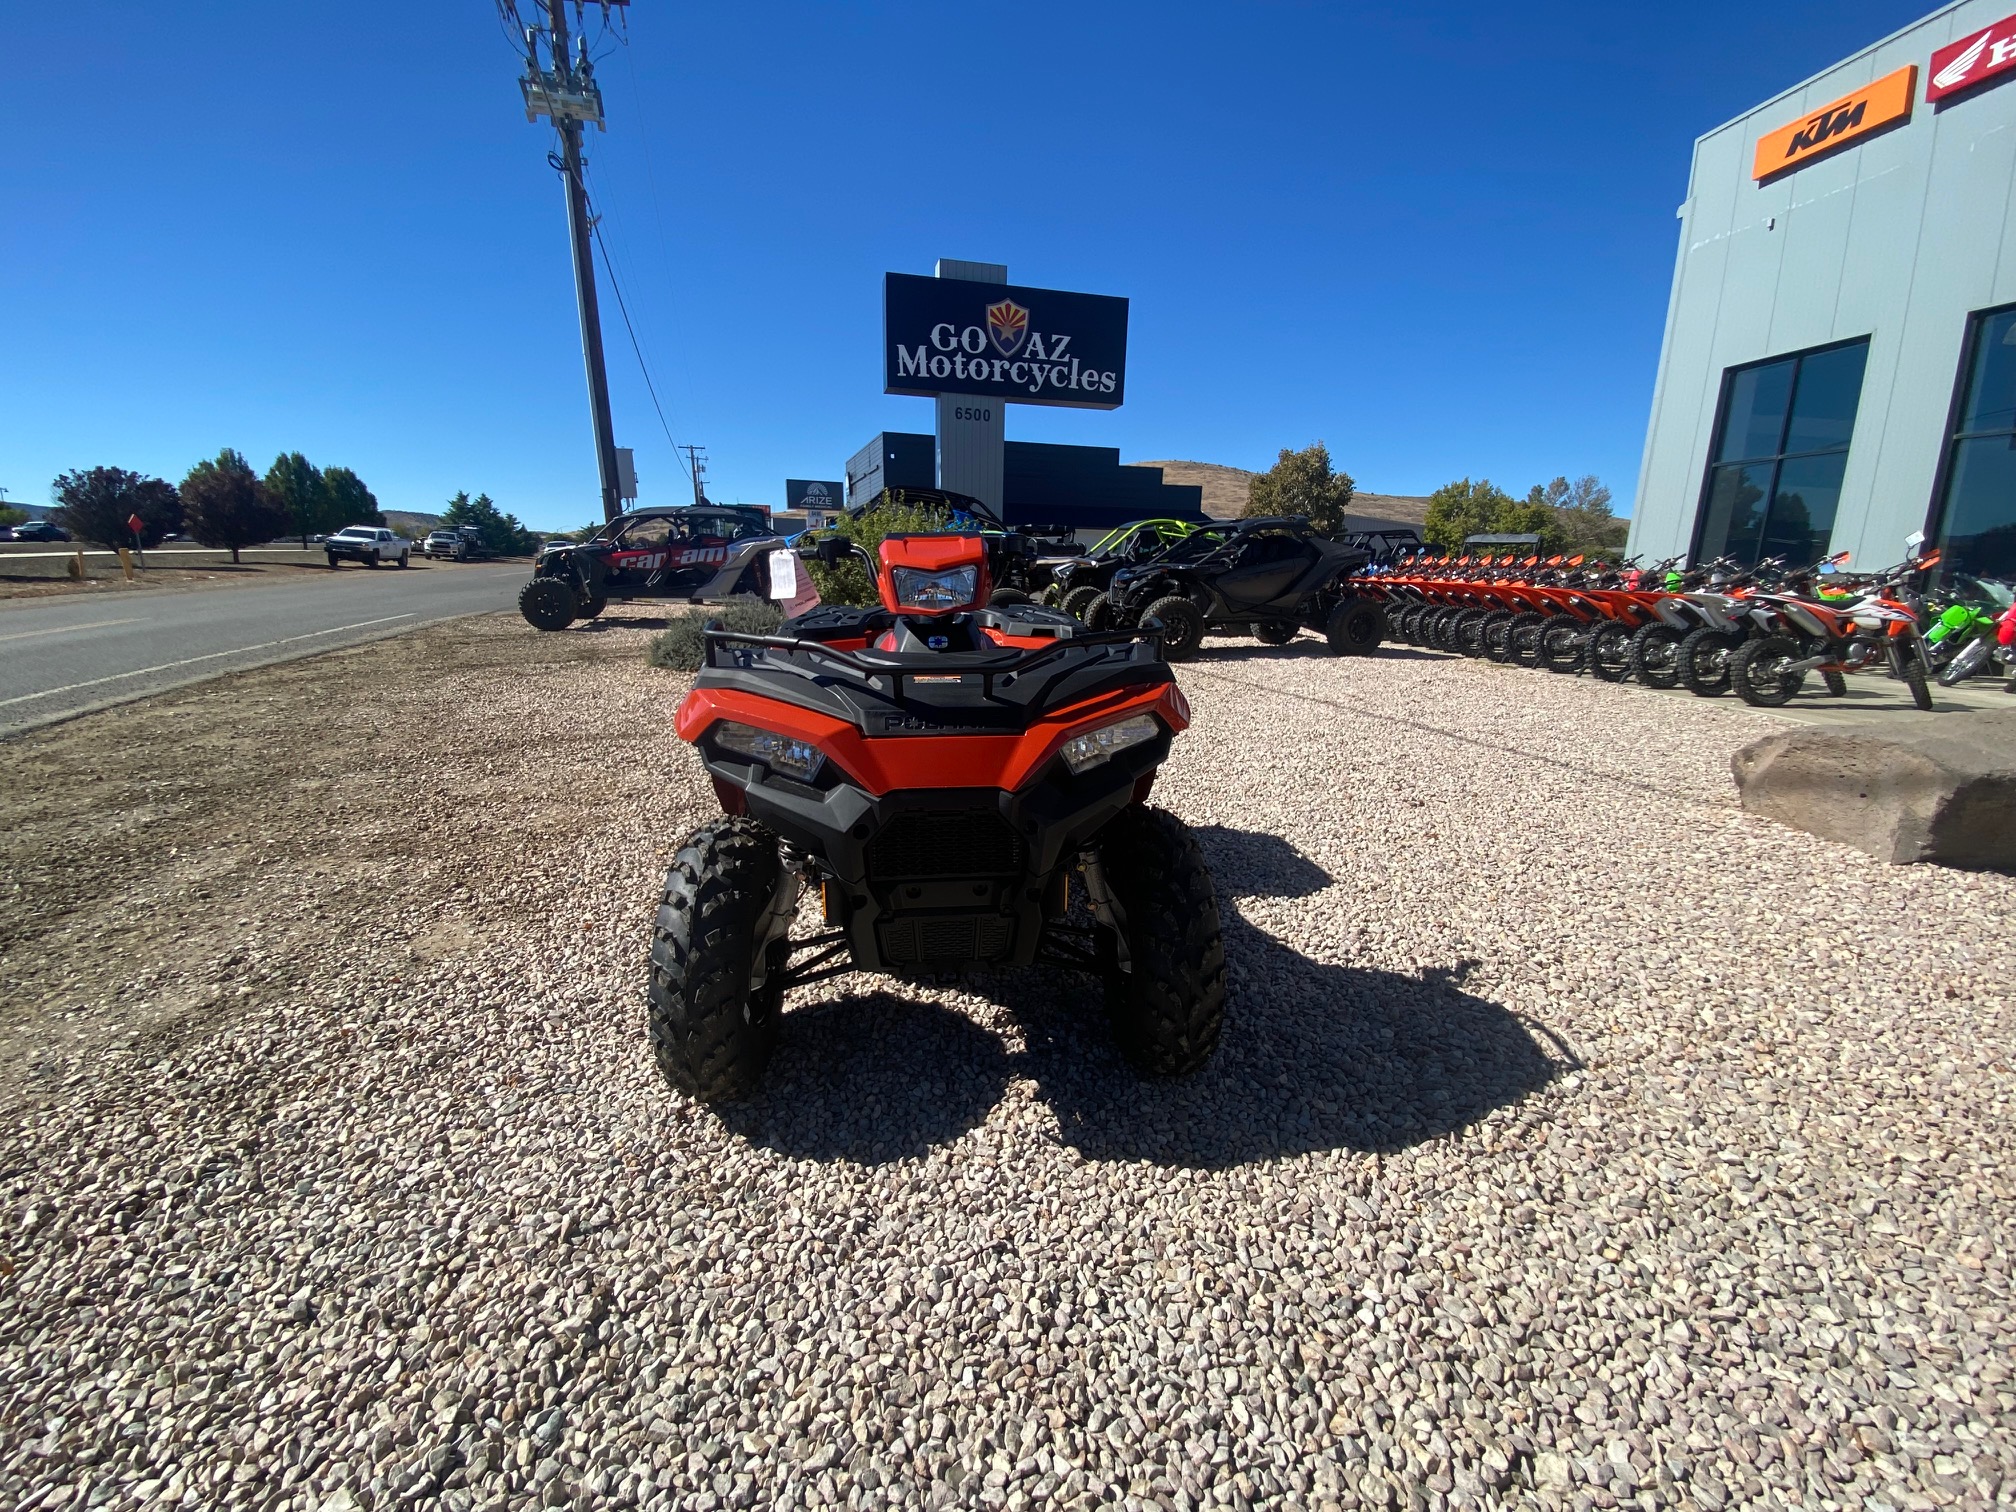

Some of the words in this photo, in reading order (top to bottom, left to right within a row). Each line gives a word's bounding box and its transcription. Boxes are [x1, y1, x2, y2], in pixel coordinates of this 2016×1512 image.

[1785, 99, 1868, 159] KTM
[930, 323, 988, 354] GO
[1022, 332, 1072, 363] AZ
[896, 344, 1117, 393] Motorcycles
[954, 406, 991, 422] 6500
[800, 496, 833, 505] ARIZE
